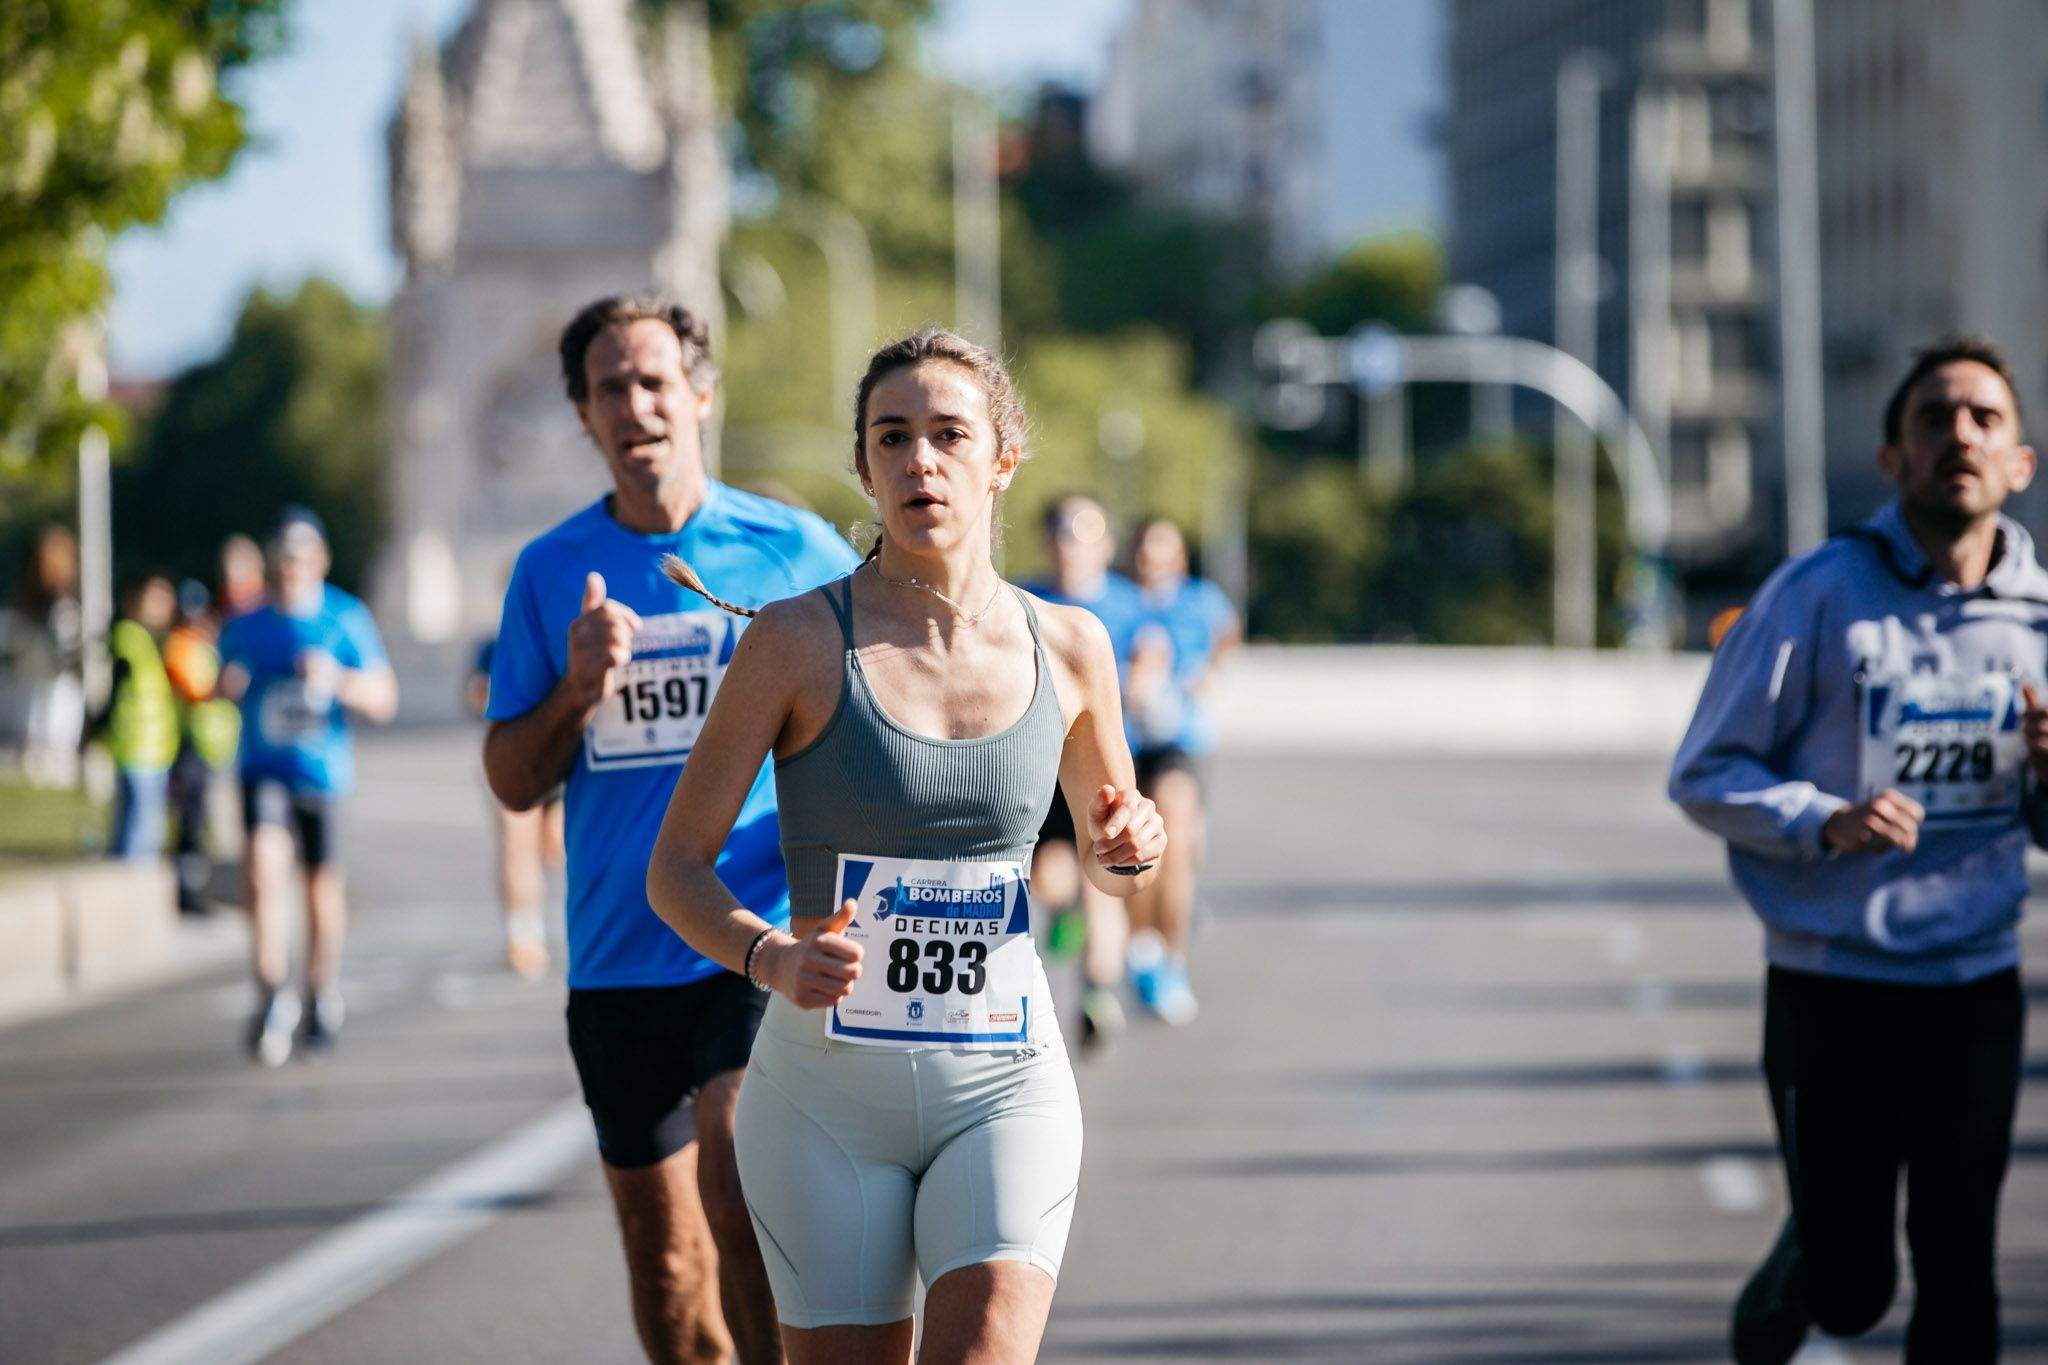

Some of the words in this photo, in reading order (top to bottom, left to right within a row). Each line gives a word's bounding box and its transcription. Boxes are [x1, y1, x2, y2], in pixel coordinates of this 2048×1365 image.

[617, 676, 709, 721] 1597
[1897, 742, 1992, 782] 2229
[911, 878, 947, 887] CARRERA
[909, 888, 1002, 903] BOMBEROS
[946, 904, 960, 917] de
[963, 904, 1002, 917] MADRID
[895, 918, 998, 935] DECIMAS
[887, 938, 988, 995] 833
